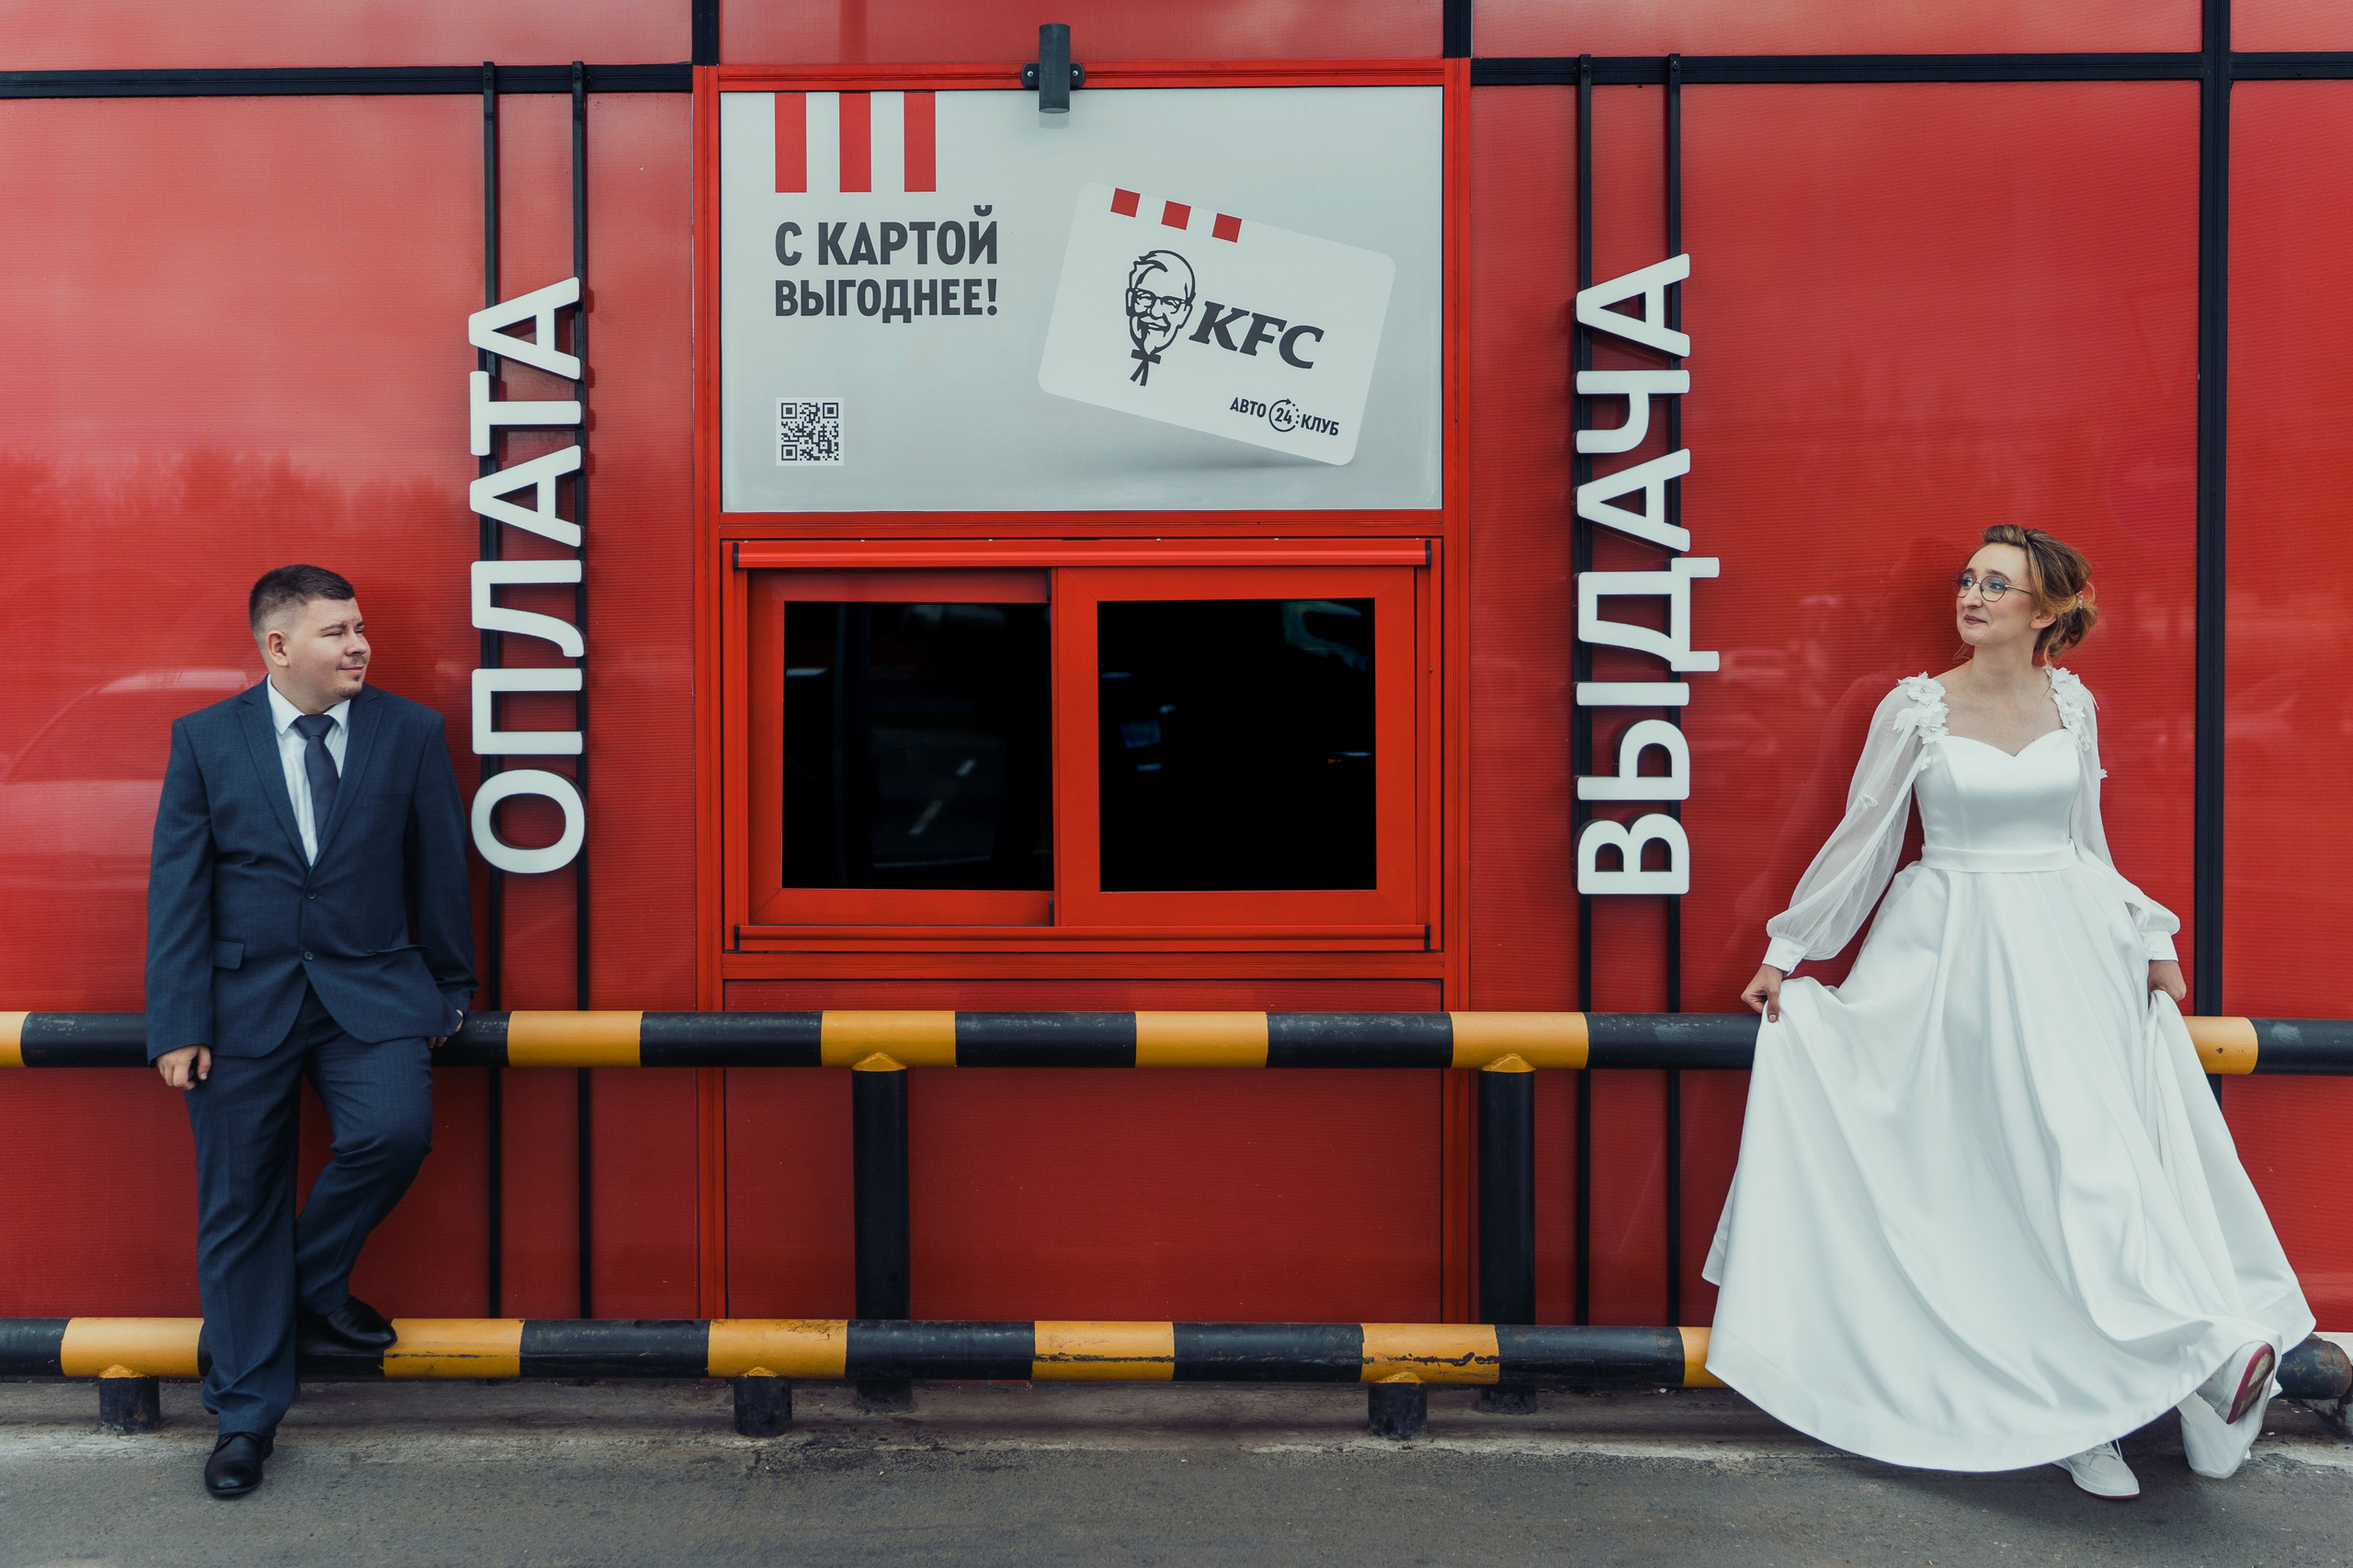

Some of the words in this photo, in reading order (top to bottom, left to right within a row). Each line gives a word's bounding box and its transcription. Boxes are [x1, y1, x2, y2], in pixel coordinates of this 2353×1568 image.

[774, 221, 802, 267] С
[818, 204, 998, 267] КАРТОЙ
[774, 278, 999, 324] ВЫГОДНЕЕ!
[1188, 301, 1325, 370] KFC
[1229, 396, 1267, 418] АВТО
[1274, 406, 1293, 426] 24
[1300, 413, 1340, 437] КЛУБ
[468, 276, 585, 875] ОПЛАТА
[1575, 252, 1721, 895] ВЫДАЧА
